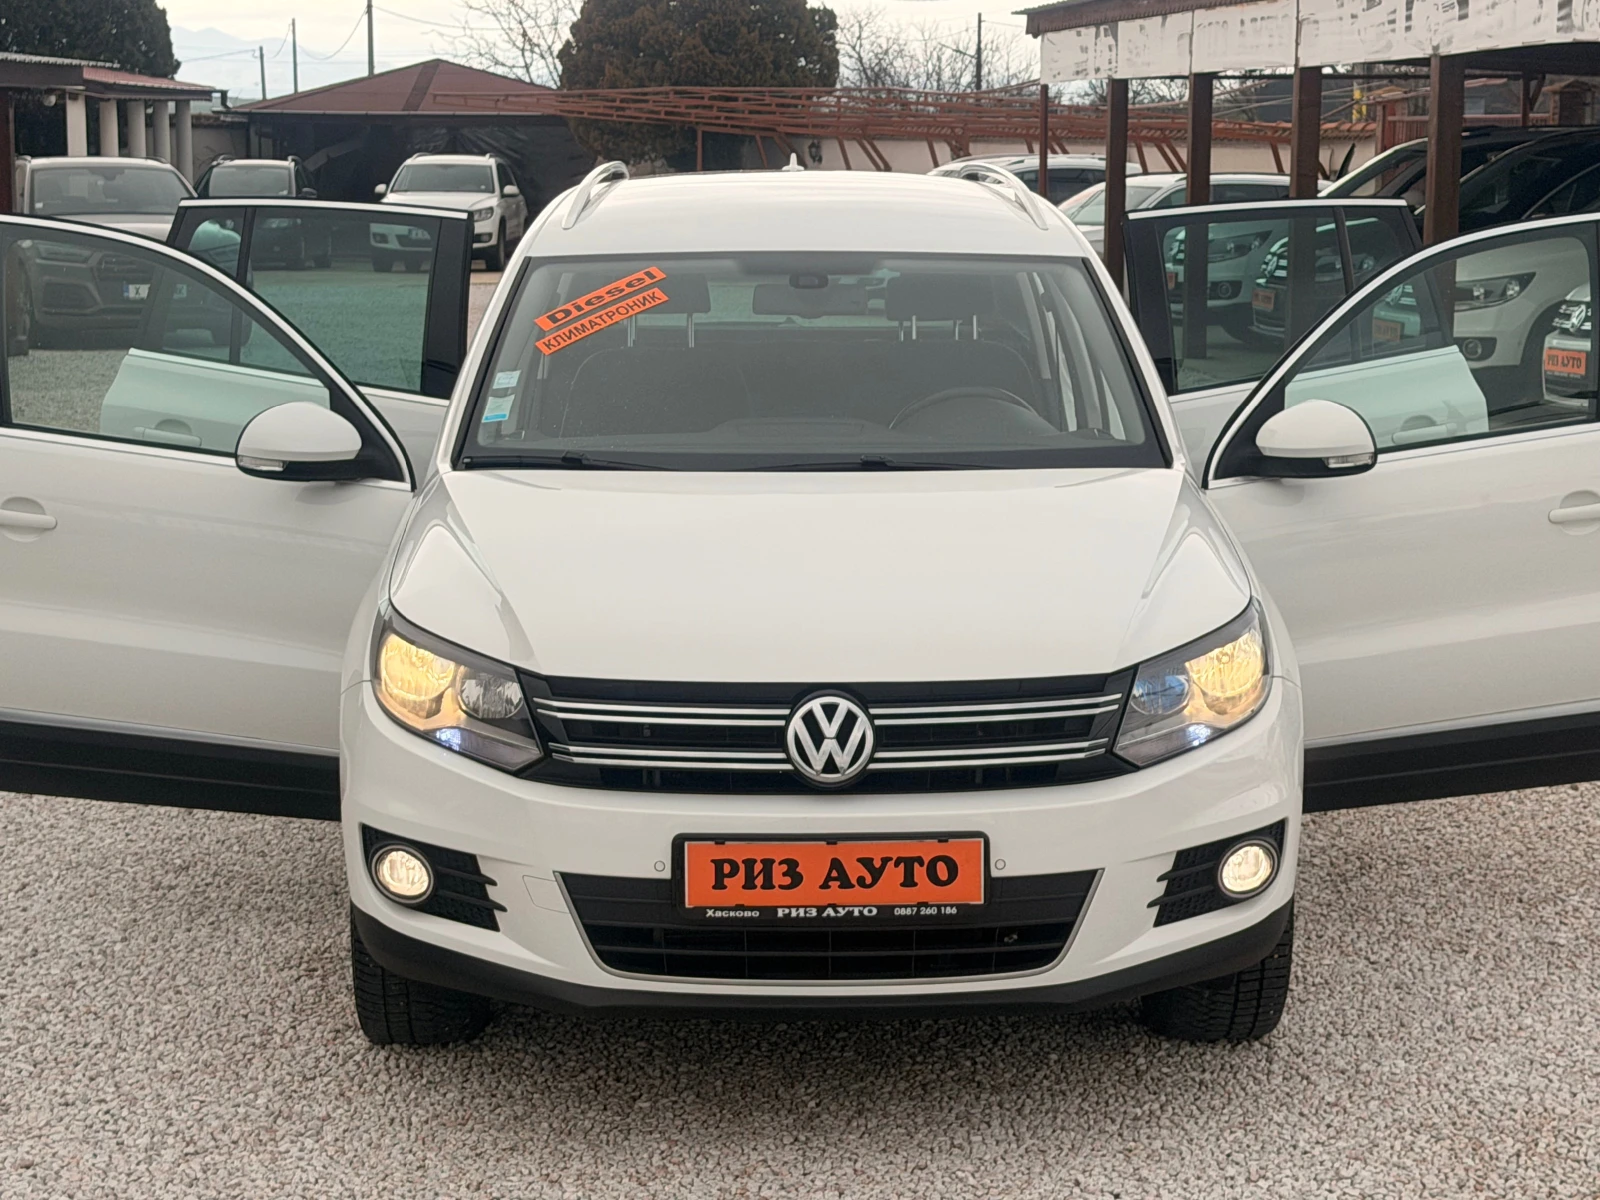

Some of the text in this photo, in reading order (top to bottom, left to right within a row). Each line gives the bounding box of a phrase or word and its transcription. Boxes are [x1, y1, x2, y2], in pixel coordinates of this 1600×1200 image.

[546, 270, 658, 325] Diesel
[542, 291, 662, 351] КЛИМАТРОНИК
[710, 854, 959, 890] РИЗ АУТО
[705, 905, 957, 918] Хасково РИЗ АУТО 0887 260 186
